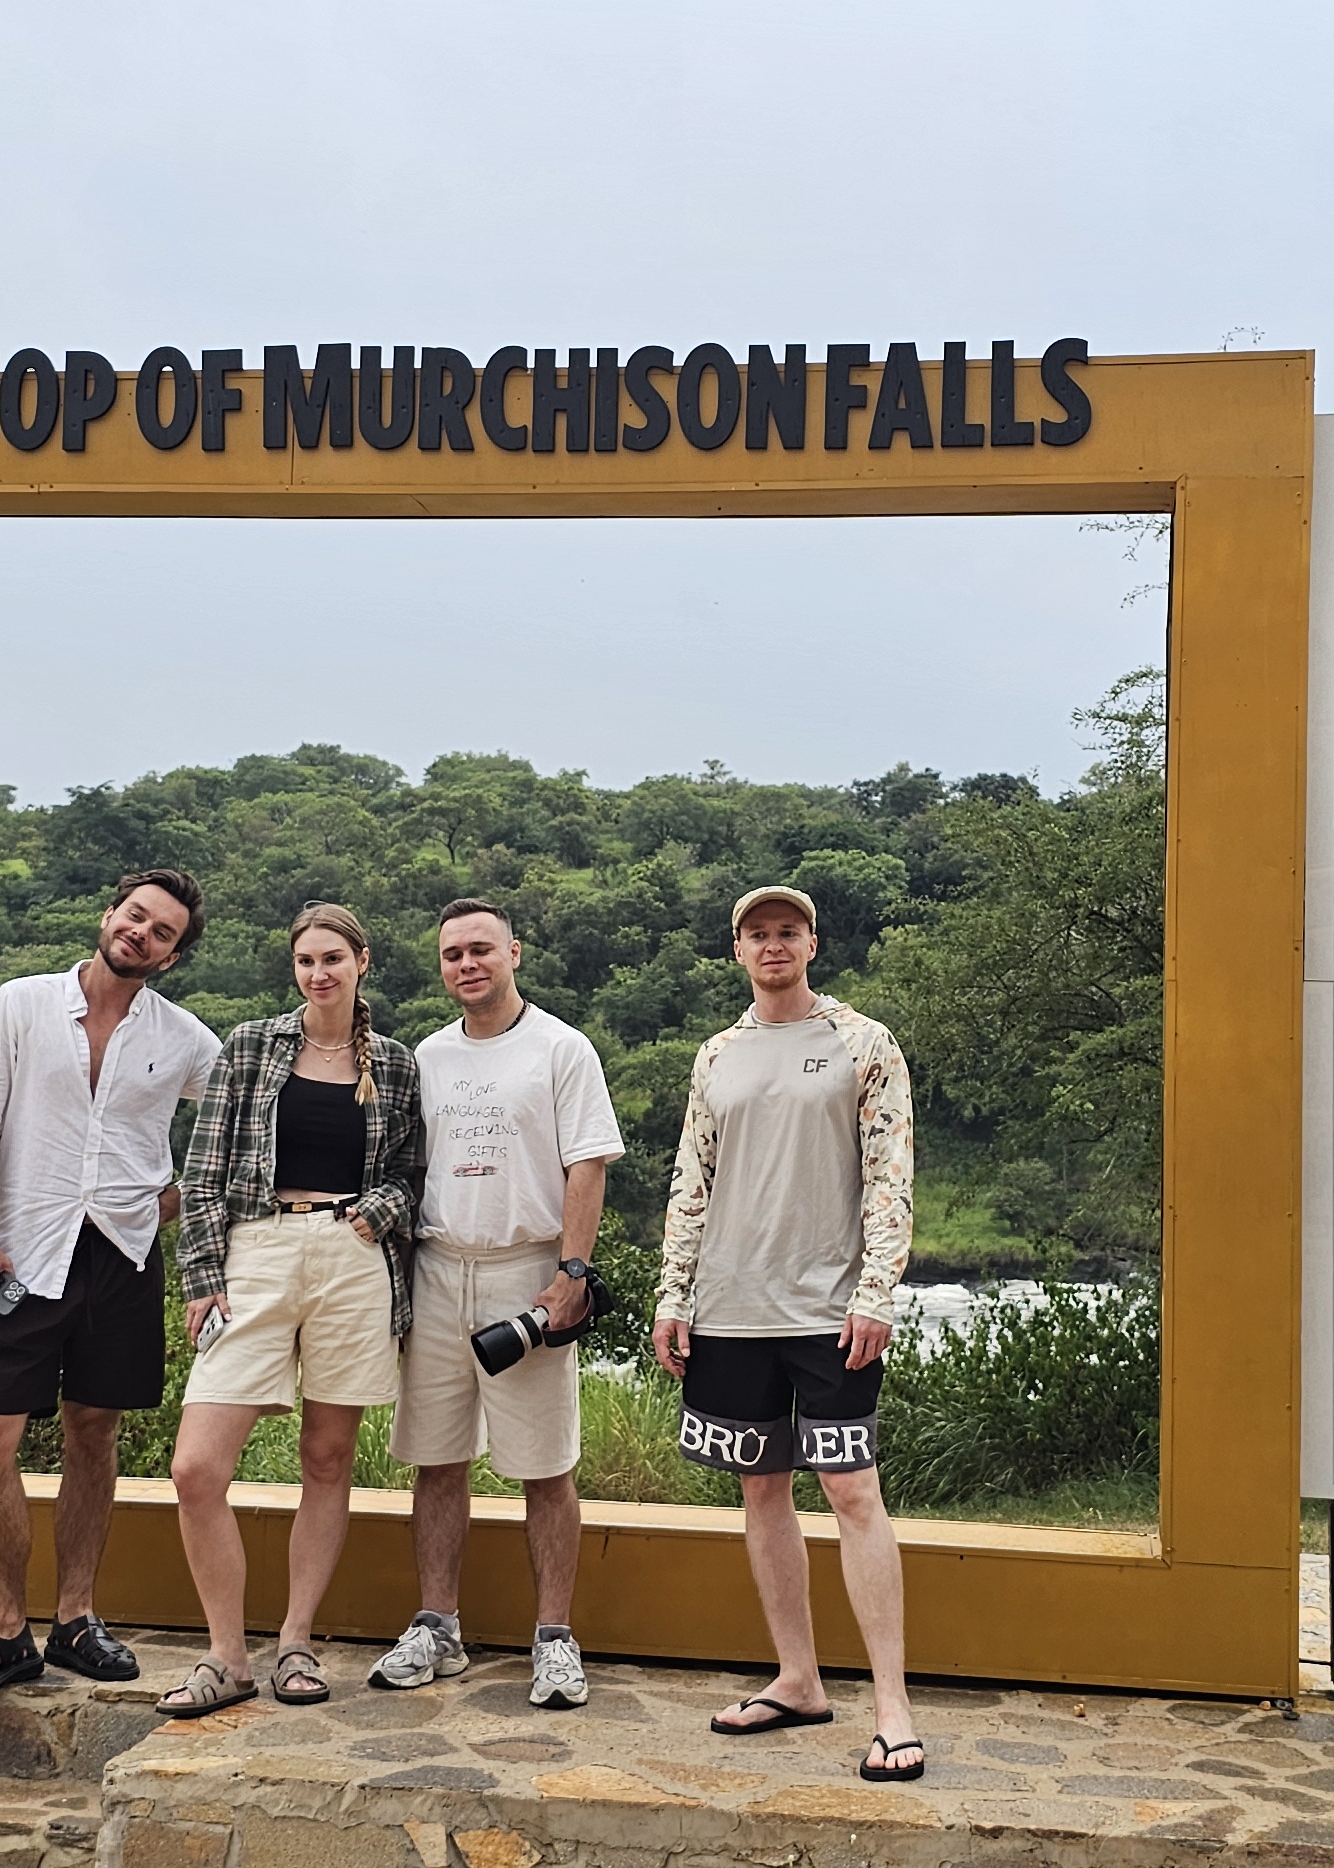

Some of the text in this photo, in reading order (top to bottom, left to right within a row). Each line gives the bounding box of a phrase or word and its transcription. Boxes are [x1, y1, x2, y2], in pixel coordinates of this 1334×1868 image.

[135, 346, 245, 452] OF
[263, 342, 808, 453] MURCHISON
[823, 338, 1092, 451] FALLS
[803, 1058, 829, 1074] CF
[451, 1079, 498, 1101] MY LOVE
